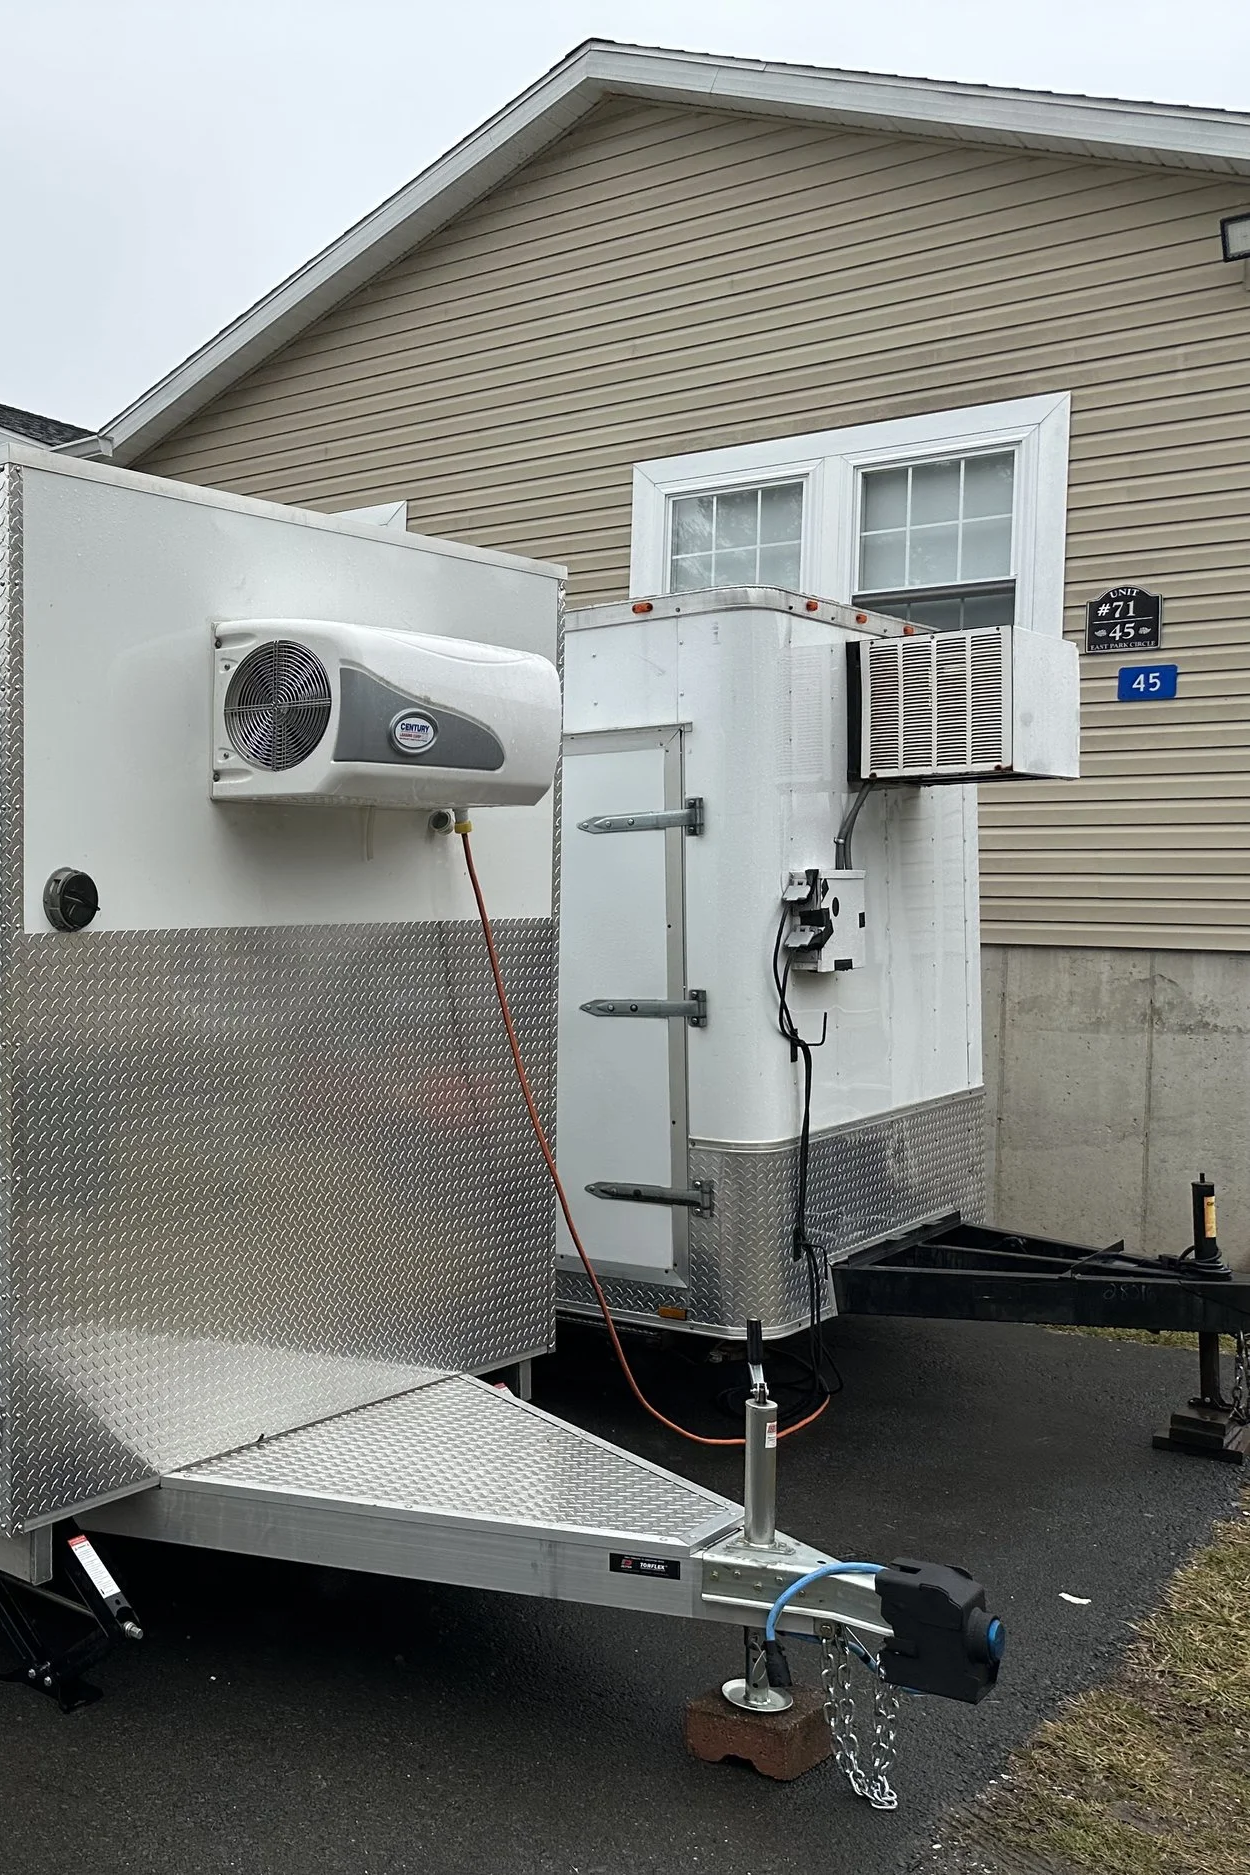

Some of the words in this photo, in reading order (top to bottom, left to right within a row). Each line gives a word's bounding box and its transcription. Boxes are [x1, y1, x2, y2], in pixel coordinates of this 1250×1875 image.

[1110, 588, 1140, 598] UNIT
[1097, 600, 1136, 618] #71
[1108, 622, 1136, 641] 45
[1090, 643, 1109, 651] EAST
[1110, 642, 1129, 650] PARK
[1129, 640, 1156, 648] CIRCLE
[1132, 672, 1161, 692] 45
[400, 722, 430, 733] CENTURY
[640, 1562, 665, 1570] TORFLEX
